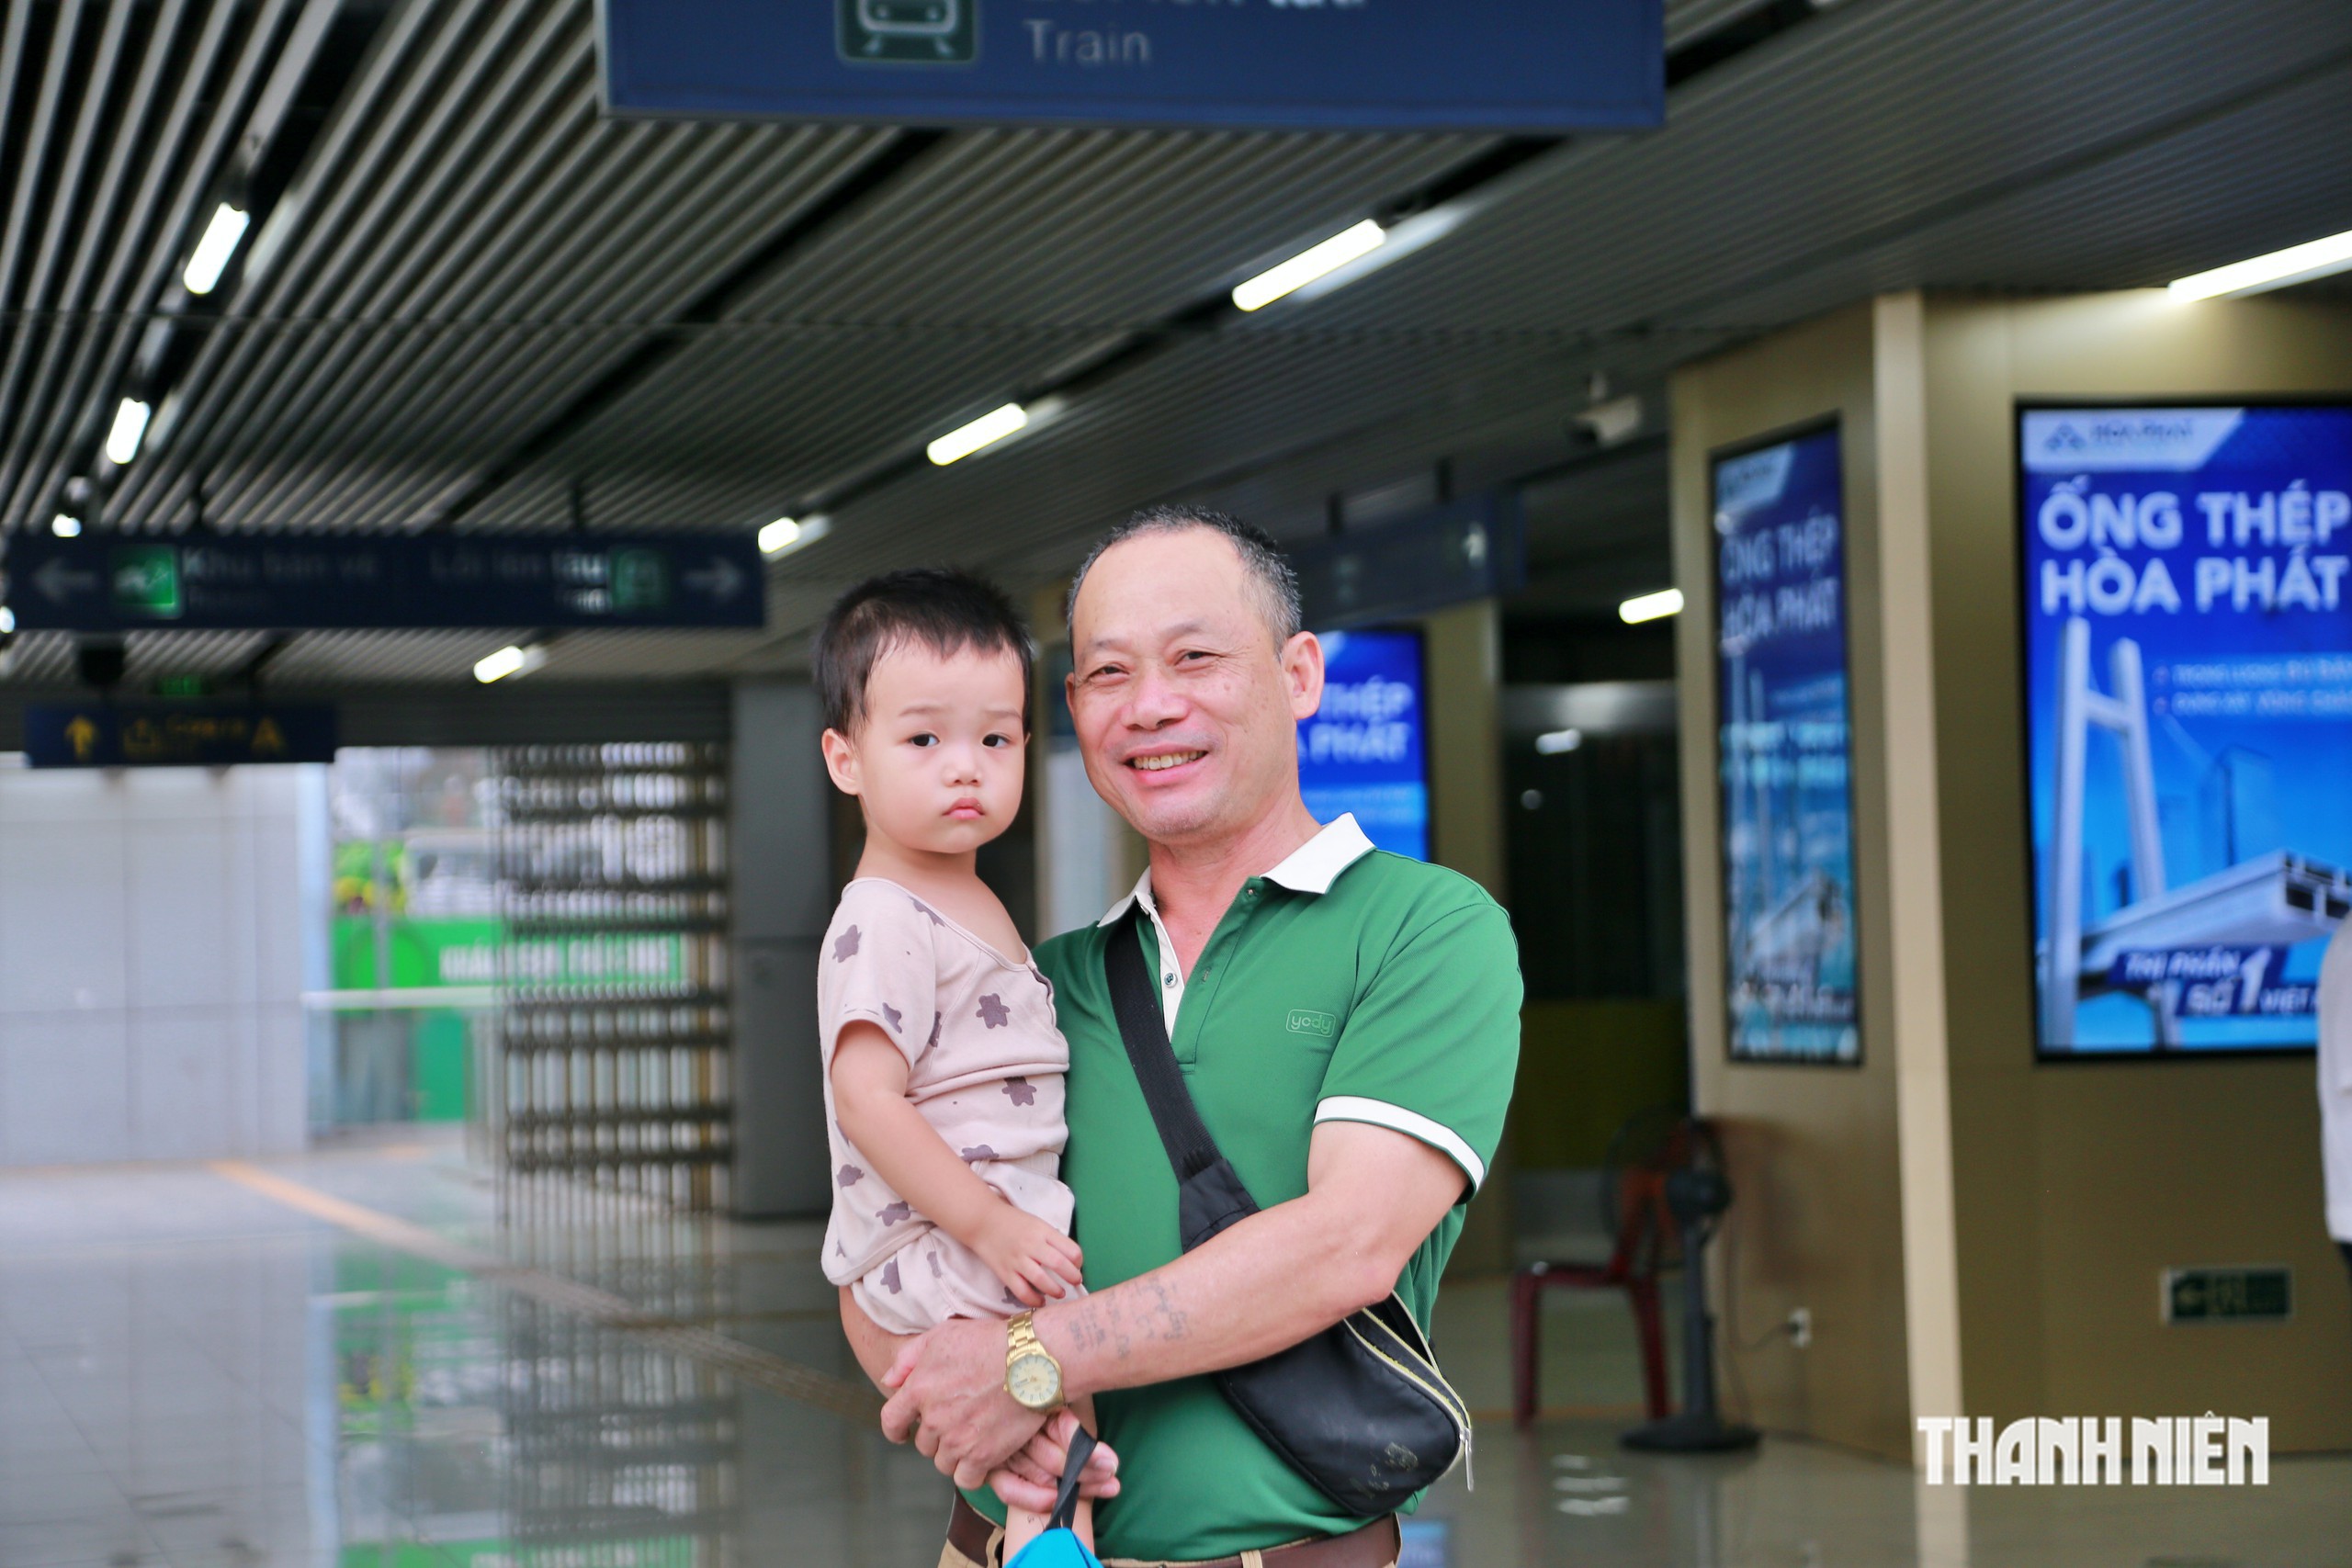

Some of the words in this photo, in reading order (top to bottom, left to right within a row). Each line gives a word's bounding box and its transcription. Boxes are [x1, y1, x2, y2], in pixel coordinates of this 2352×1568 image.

[1023, 18, 1152, 65] Train
[2038, 474, 2184, 550] ỐNG
[2196, 479, 2351, 547] THÉP
[2041, 546, 2182, 615] HÒA
[2195, 544, 2350, 614] PHÁT
[1291, 1014, 1331, 1034] yody
